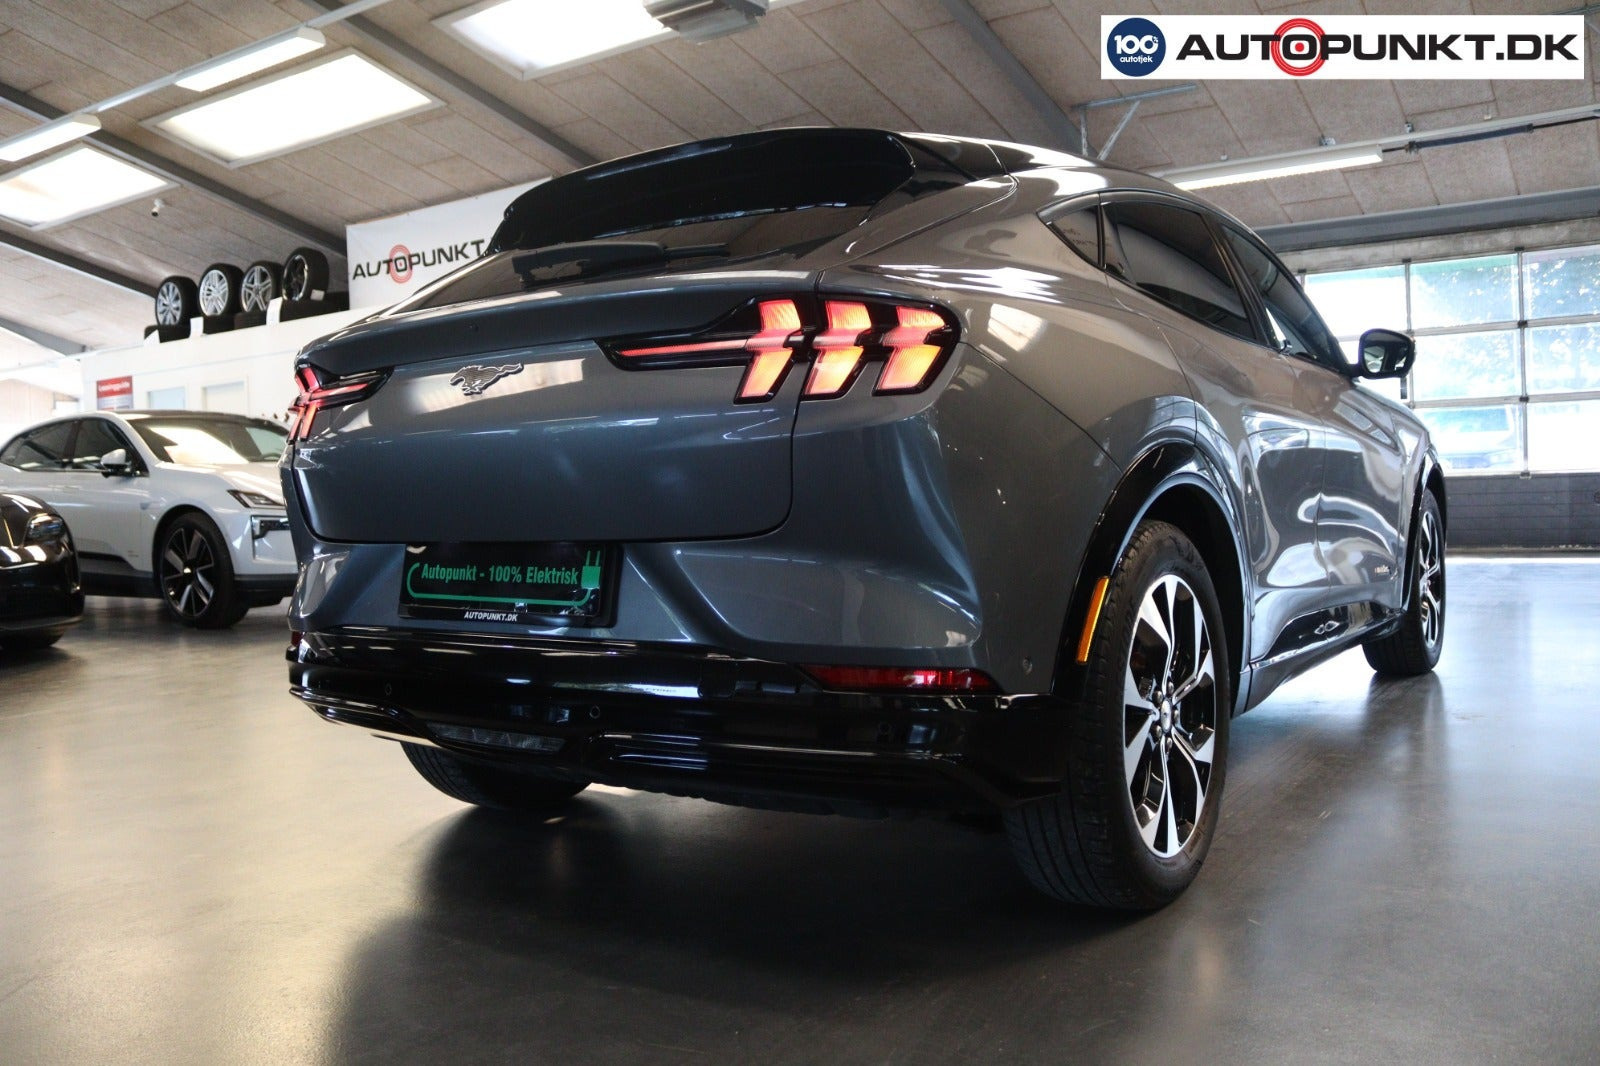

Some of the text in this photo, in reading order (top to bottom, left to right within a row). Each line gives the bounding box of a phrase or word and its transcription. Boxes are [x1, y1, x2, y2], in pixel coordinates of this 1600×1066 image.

[352, 239, 485, 280] AUTOPUNKT
[421, 563, 477, 583] Autopunkt
[489, 565, 522, 583] 100%
[526, 566, 579, 585] Elektrisk
[464, 611, 518, 621] AUTOPUNKT.DK
